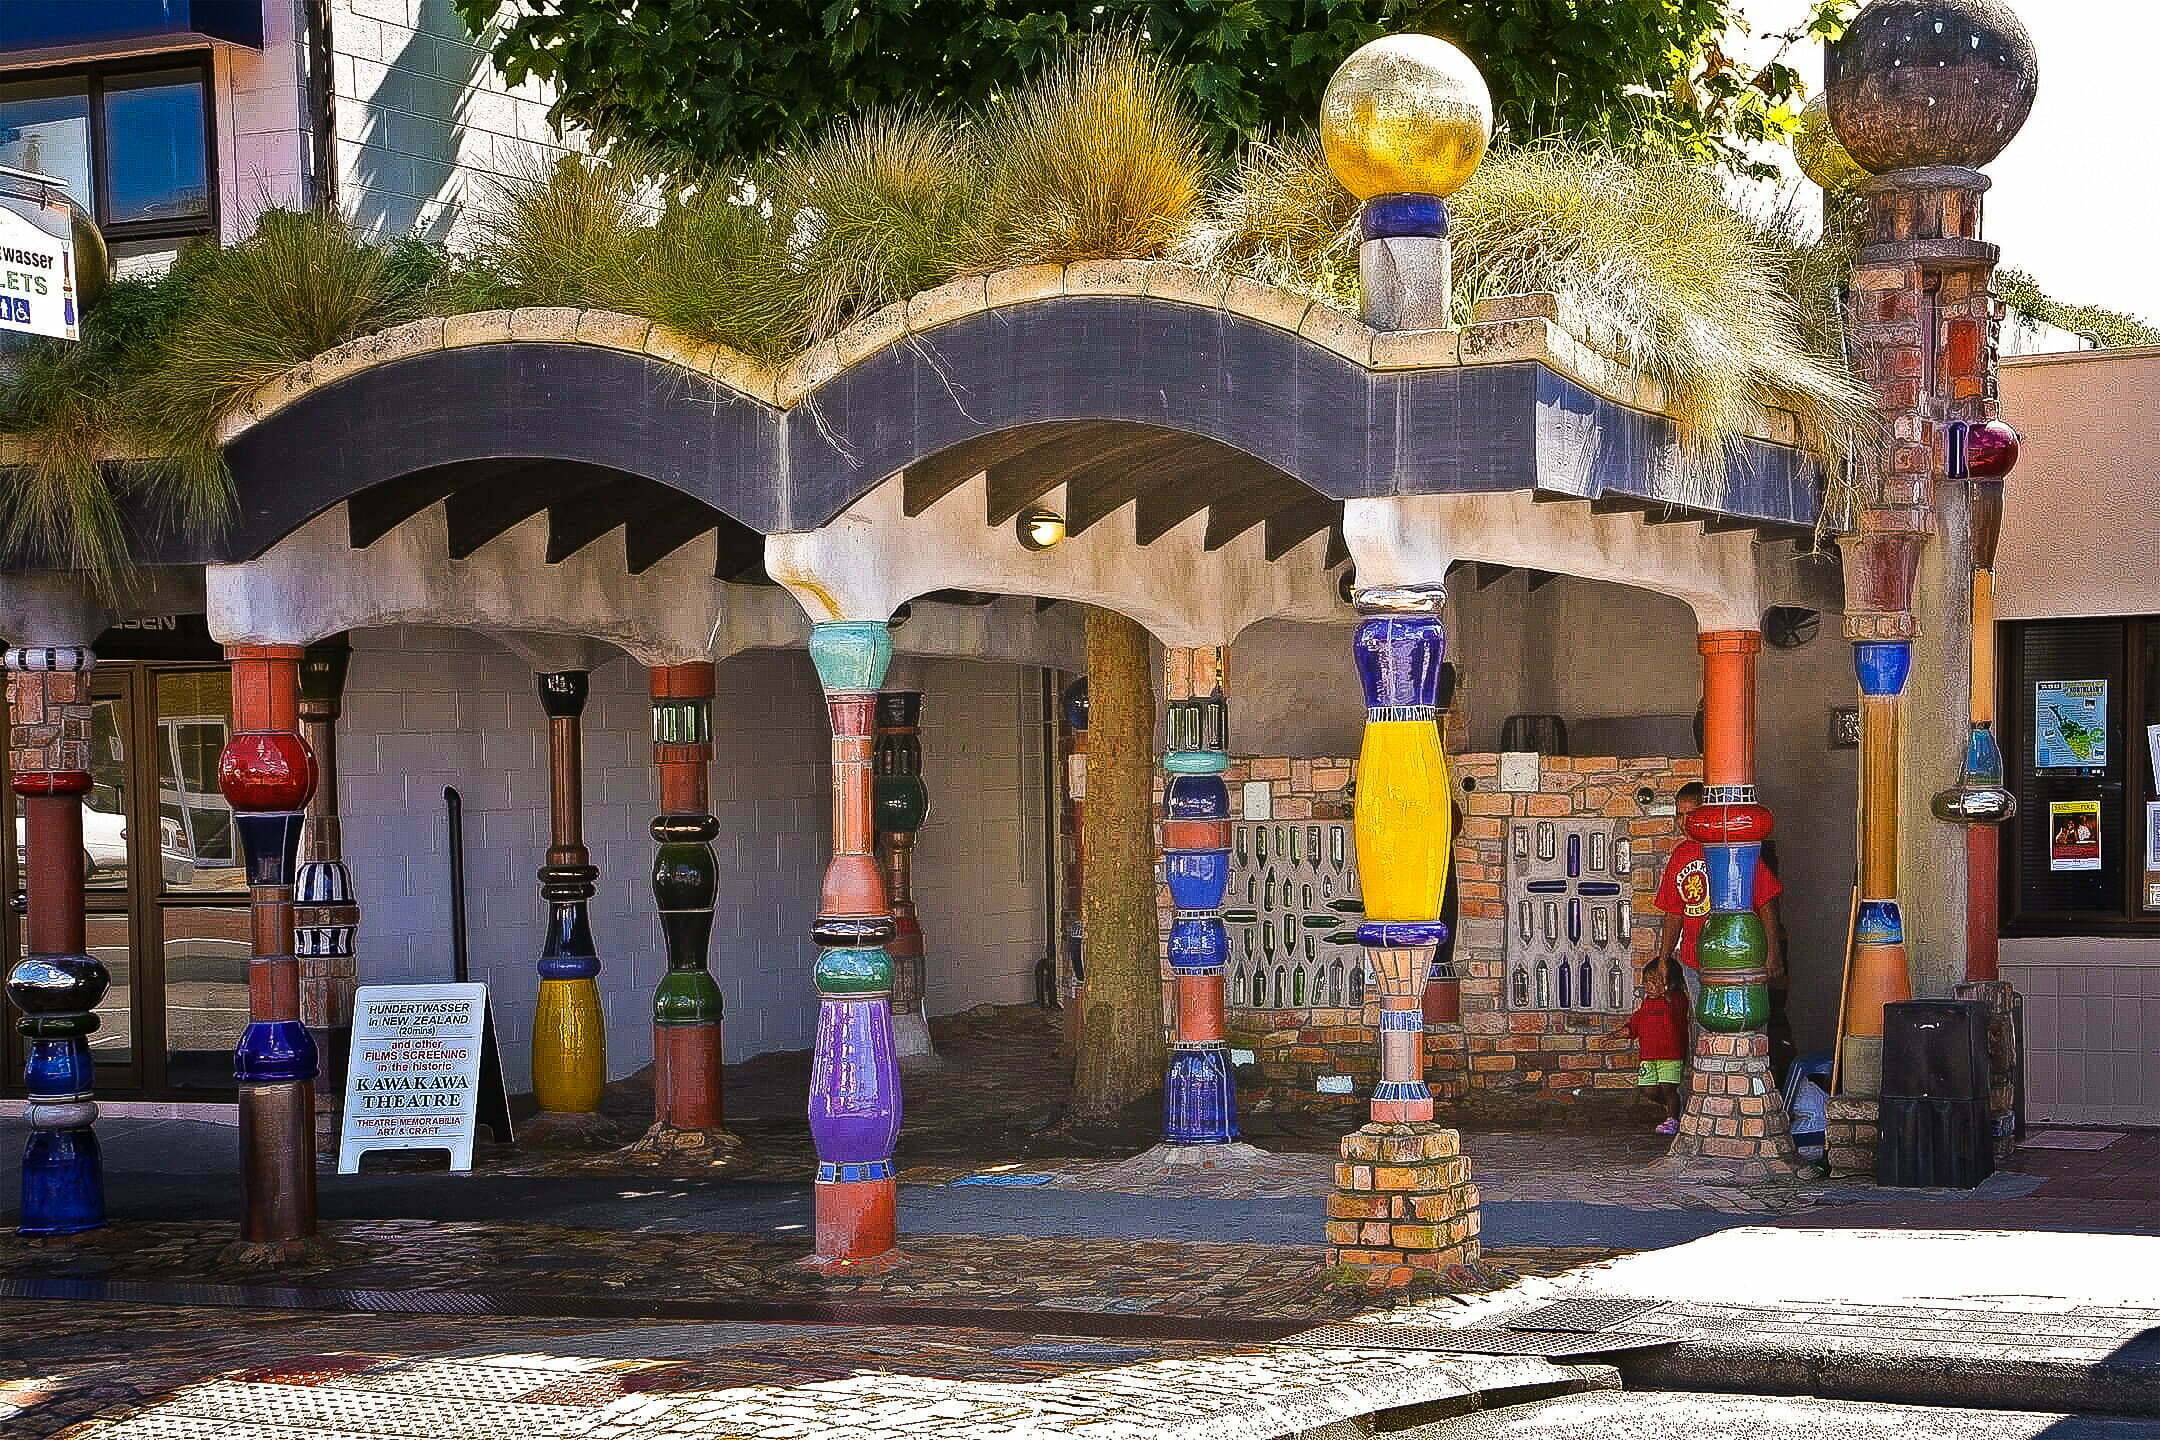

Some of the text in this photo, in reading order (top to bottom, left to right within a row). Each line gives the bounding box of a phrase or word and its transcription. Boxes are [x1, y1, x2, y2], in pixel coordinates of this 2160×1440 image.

[368, 1003, 470, 1014] HUNDERTWASSER
[381, 1017, 410, 1026] NEW
[413, 1015, 468, 1025] ZEALAND
[414, 1040, 443, 1049] other
[365, 1049, 467, 1061] FILMS SCREENING
[377, 1061, 452, 1072] in the historic
[356, 1076, 469, 1092] KAWAKAWA
[362, 1093, 462, 1108] THEATRE
[357, 1117, 460, 1127] THEATRE MEMORABILIA
[377, 1128, 396, 1136] ART
[408, 1127, 440, 1135] CRAFT
